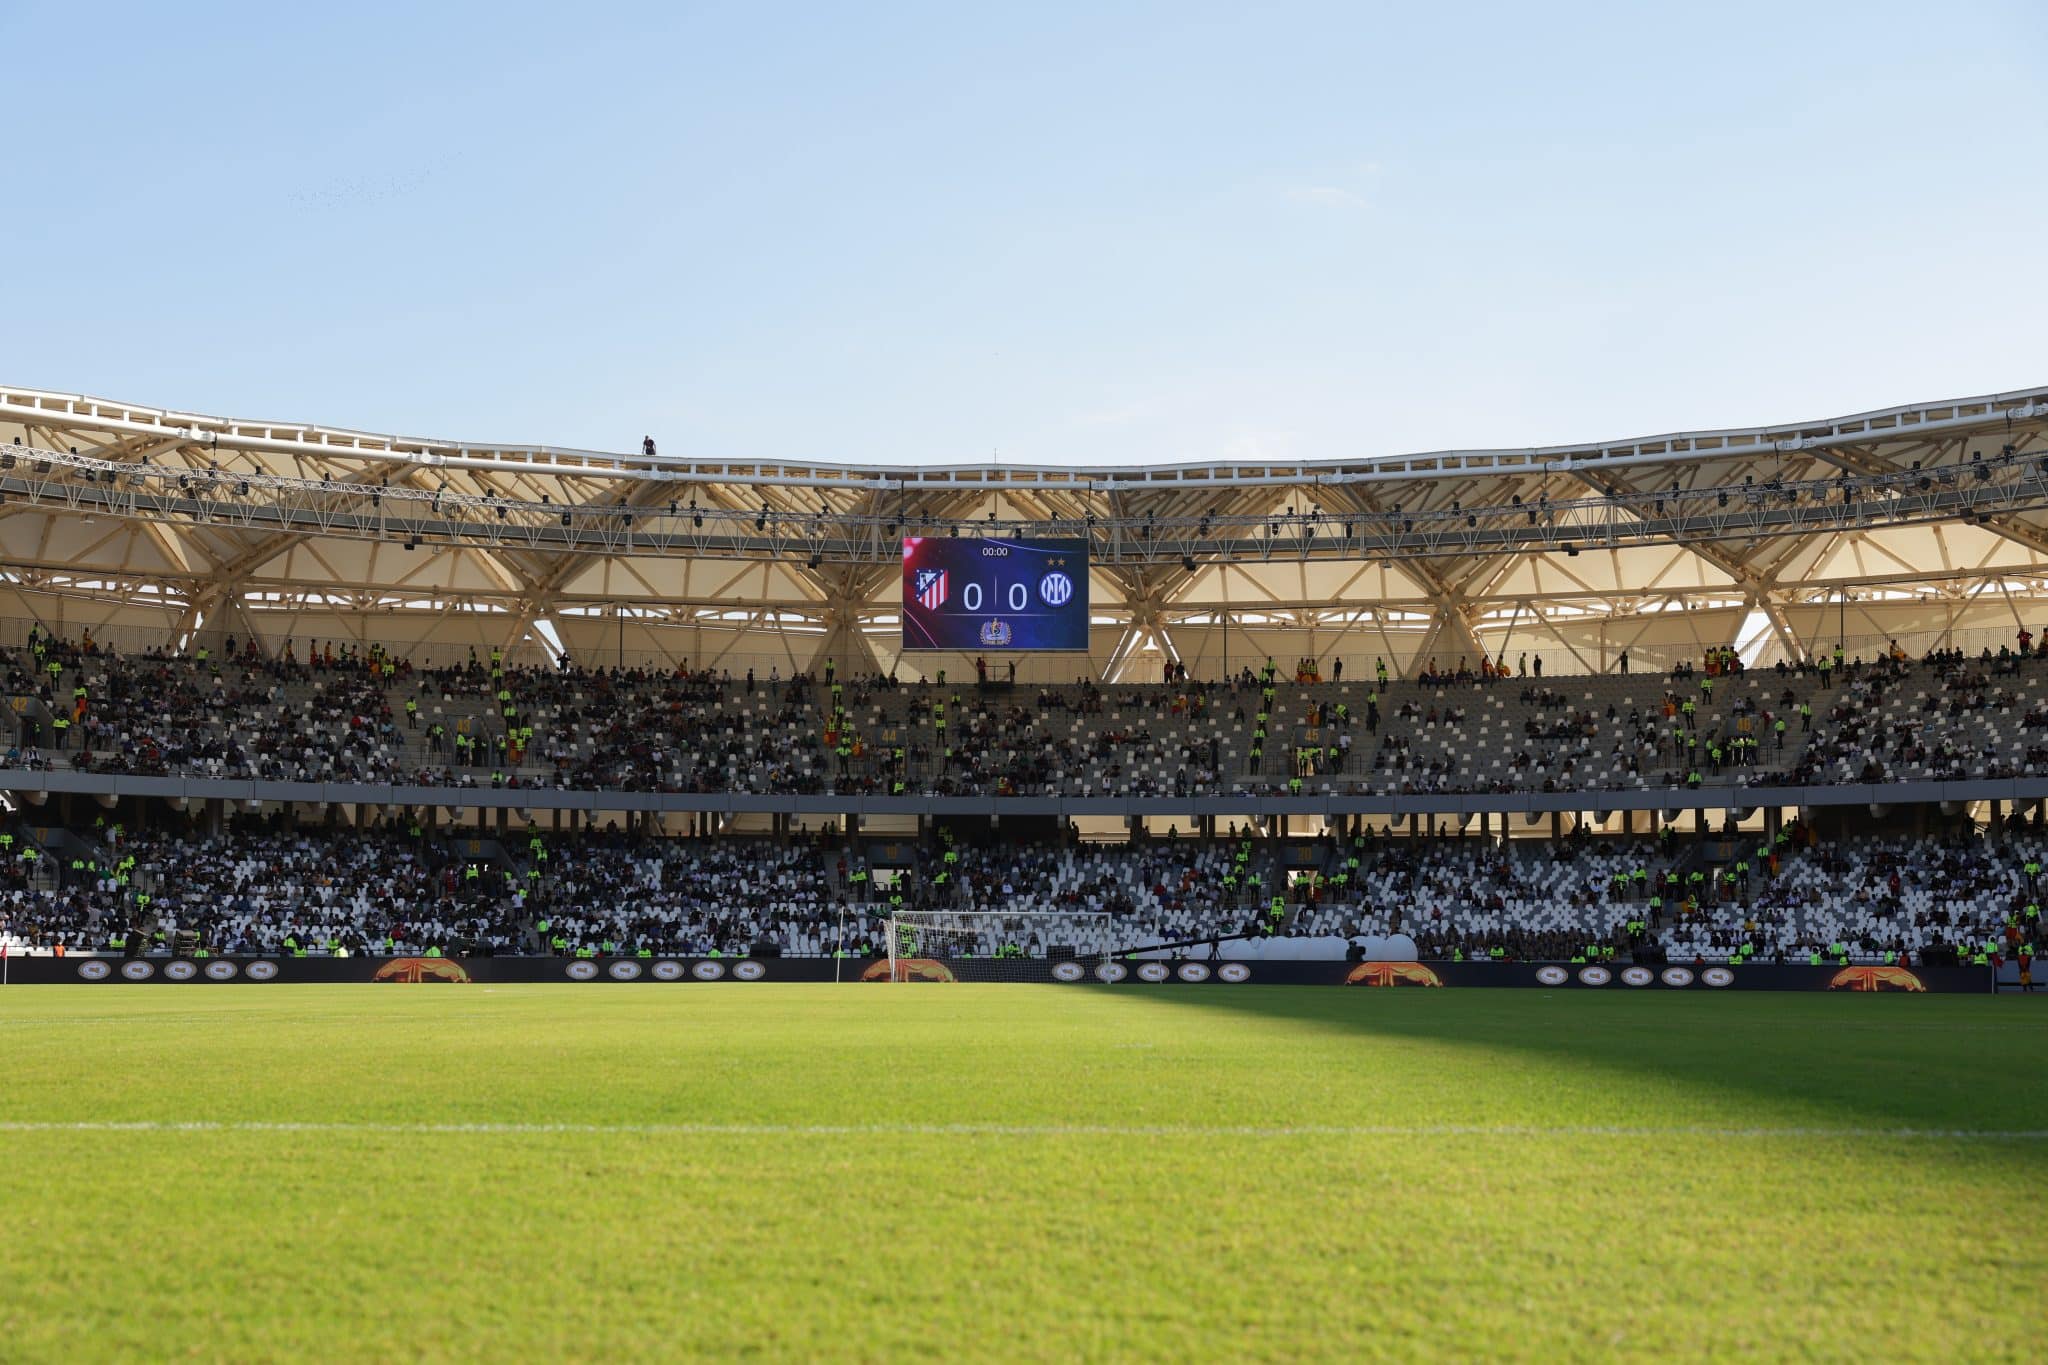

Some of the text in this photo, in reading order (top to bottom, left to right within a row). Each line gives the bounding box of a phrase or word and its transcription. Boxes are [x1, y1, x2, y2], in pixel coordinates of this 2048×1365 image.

[983, 547, 1008, 556] 00:00
[963, 583, 1028, 611] 0 0
[11, 696, 27, 712] 42
[457, 719, 471, 733] 43
[881, 728, 897, 742] 44
[1305, 728, 1320, 742] 45
